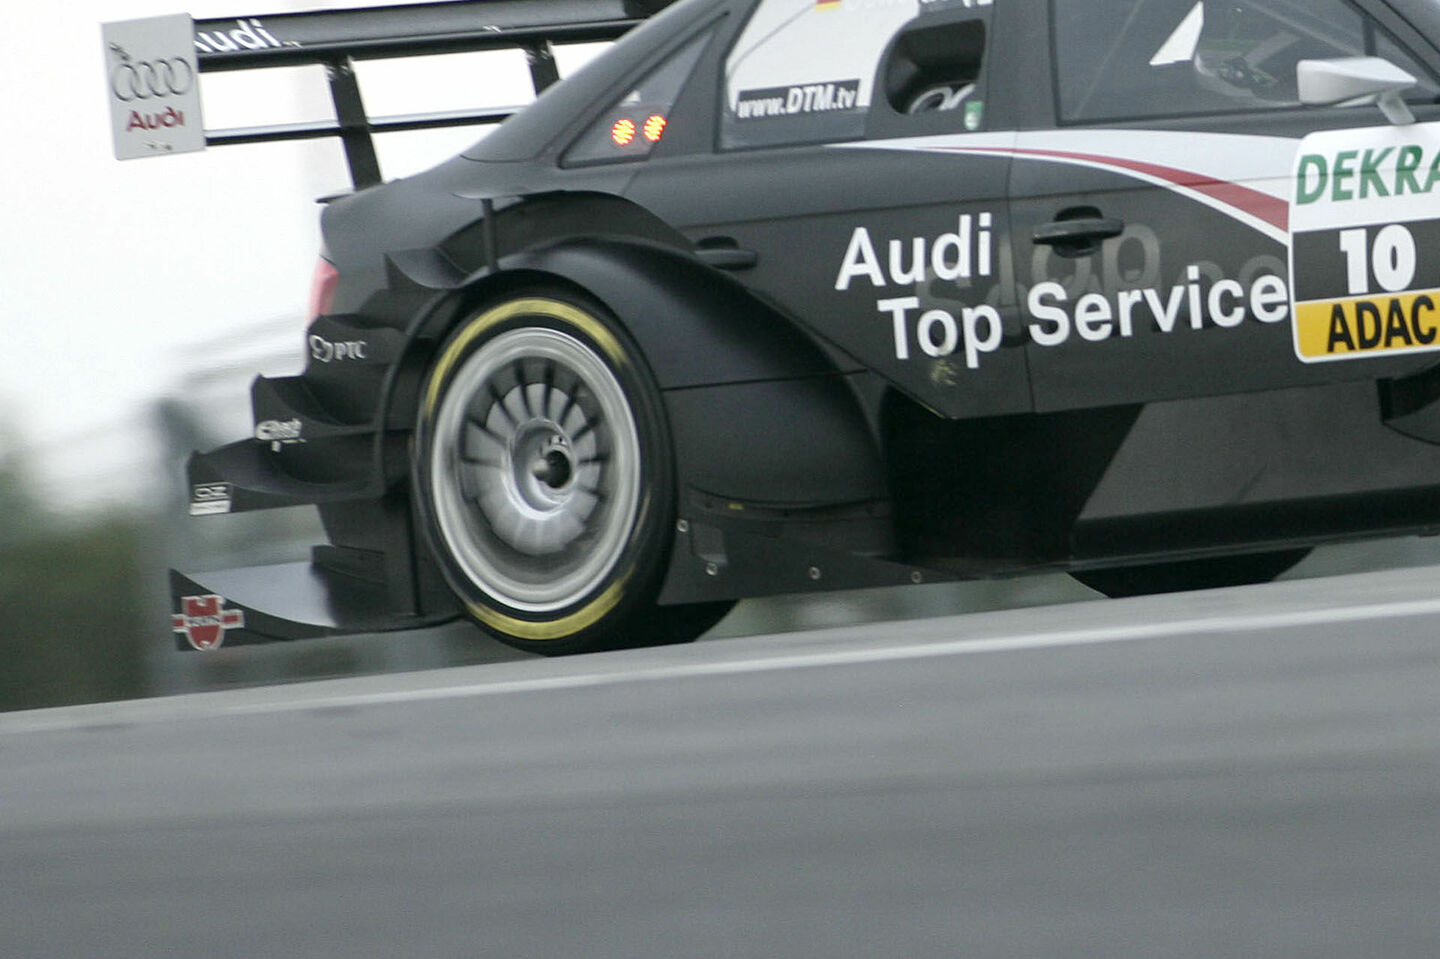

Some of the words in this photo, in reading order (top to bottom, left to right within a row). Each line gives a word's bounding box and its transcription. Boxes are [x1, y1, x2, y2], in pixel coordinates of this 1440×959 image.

[126, 105, 185, 132] Audi
[737, 83, 858, 119] www.DTM.tv
[833, 212, 993, 291] Audi
[1339, 224, 1417, 295] 10
[877, 296, 1003, 370] Top
[1027, 264, 1289, 347] Service
[1327, 295, 1438, 353] ADAC
